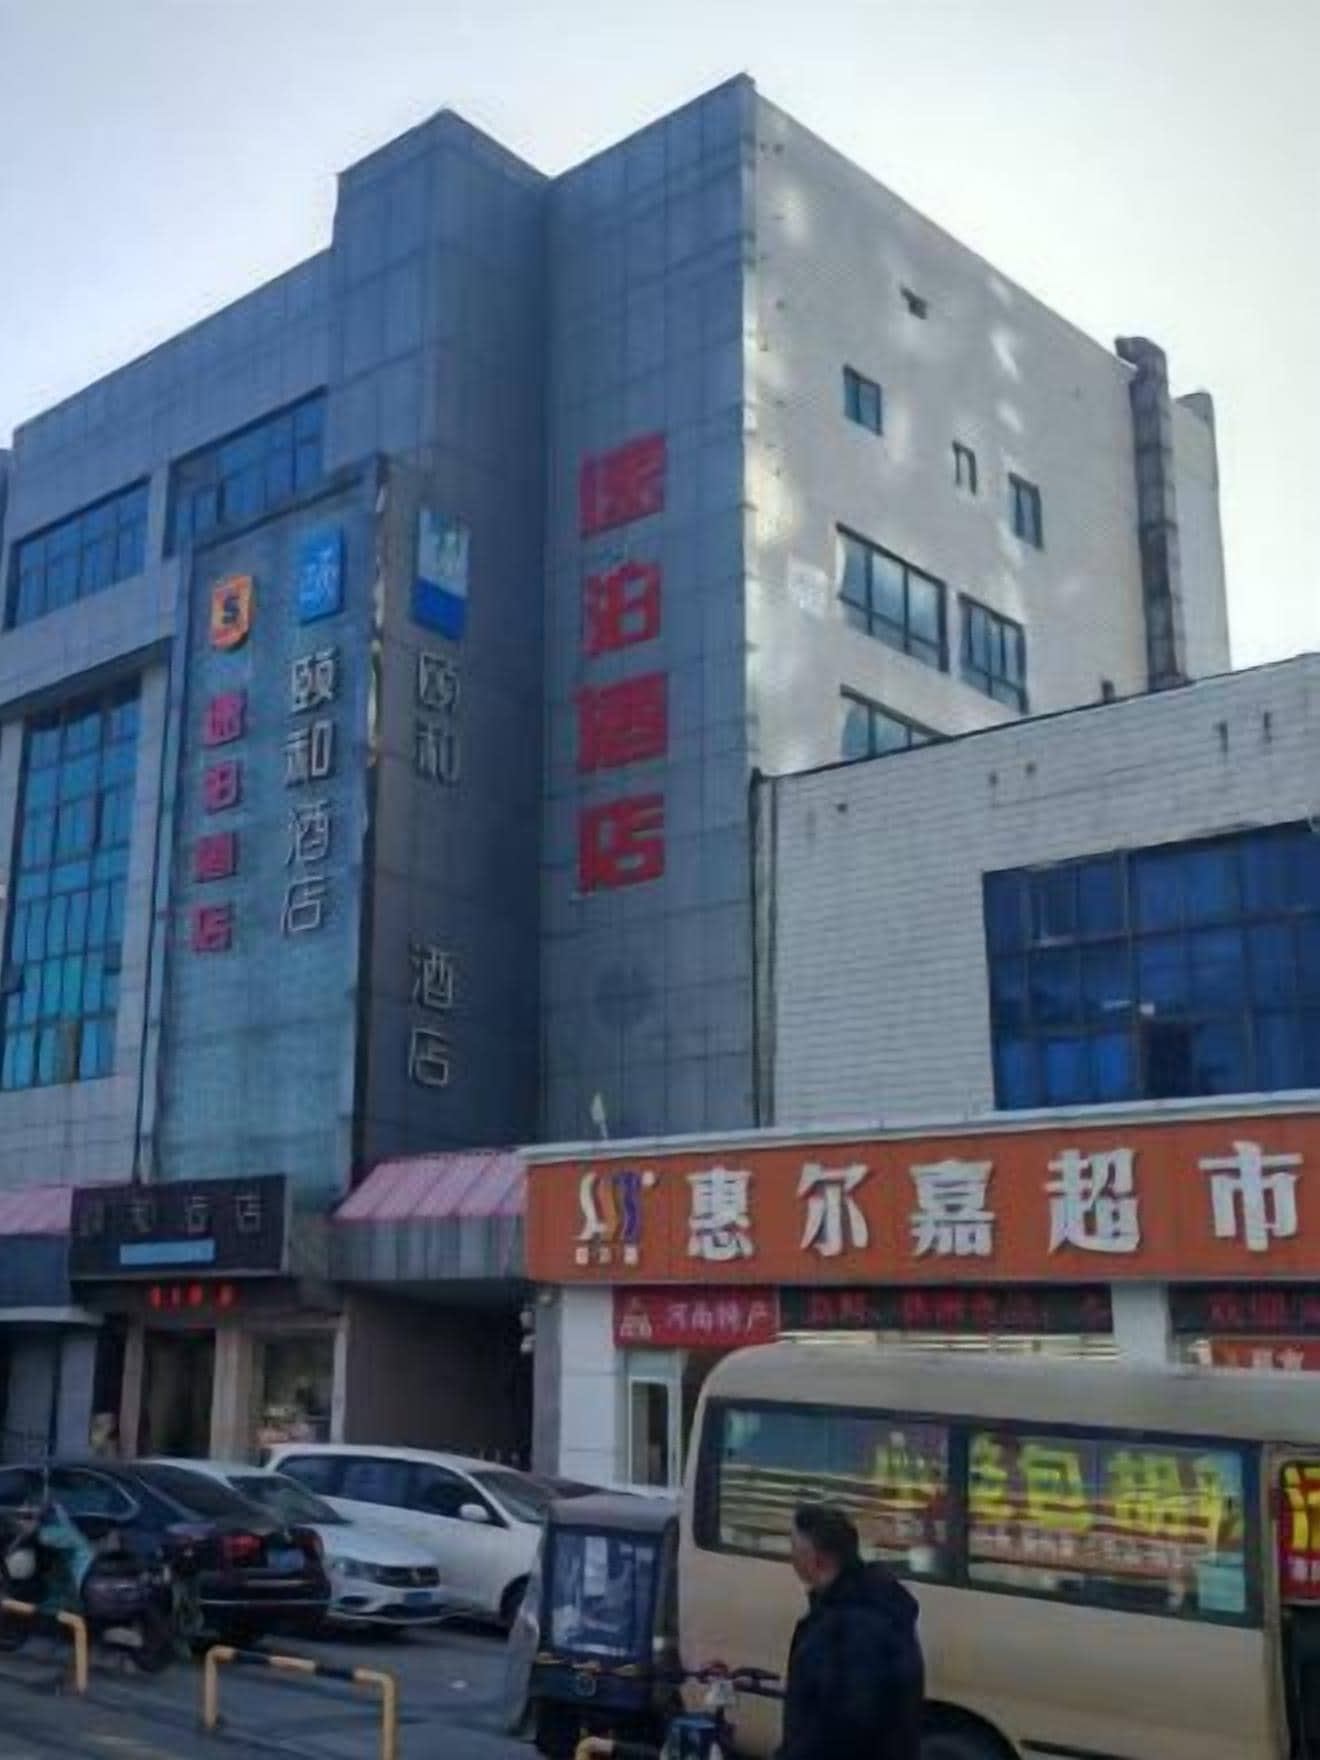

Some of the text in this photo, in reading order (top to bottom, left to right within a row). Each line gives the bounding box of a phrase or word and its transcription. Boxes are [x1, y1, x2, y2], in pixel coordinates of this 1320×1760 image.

[281, 648, 340, 936] 颐和酒店
[688, 1141, 1303, 1261] 惠尔嘉超市
